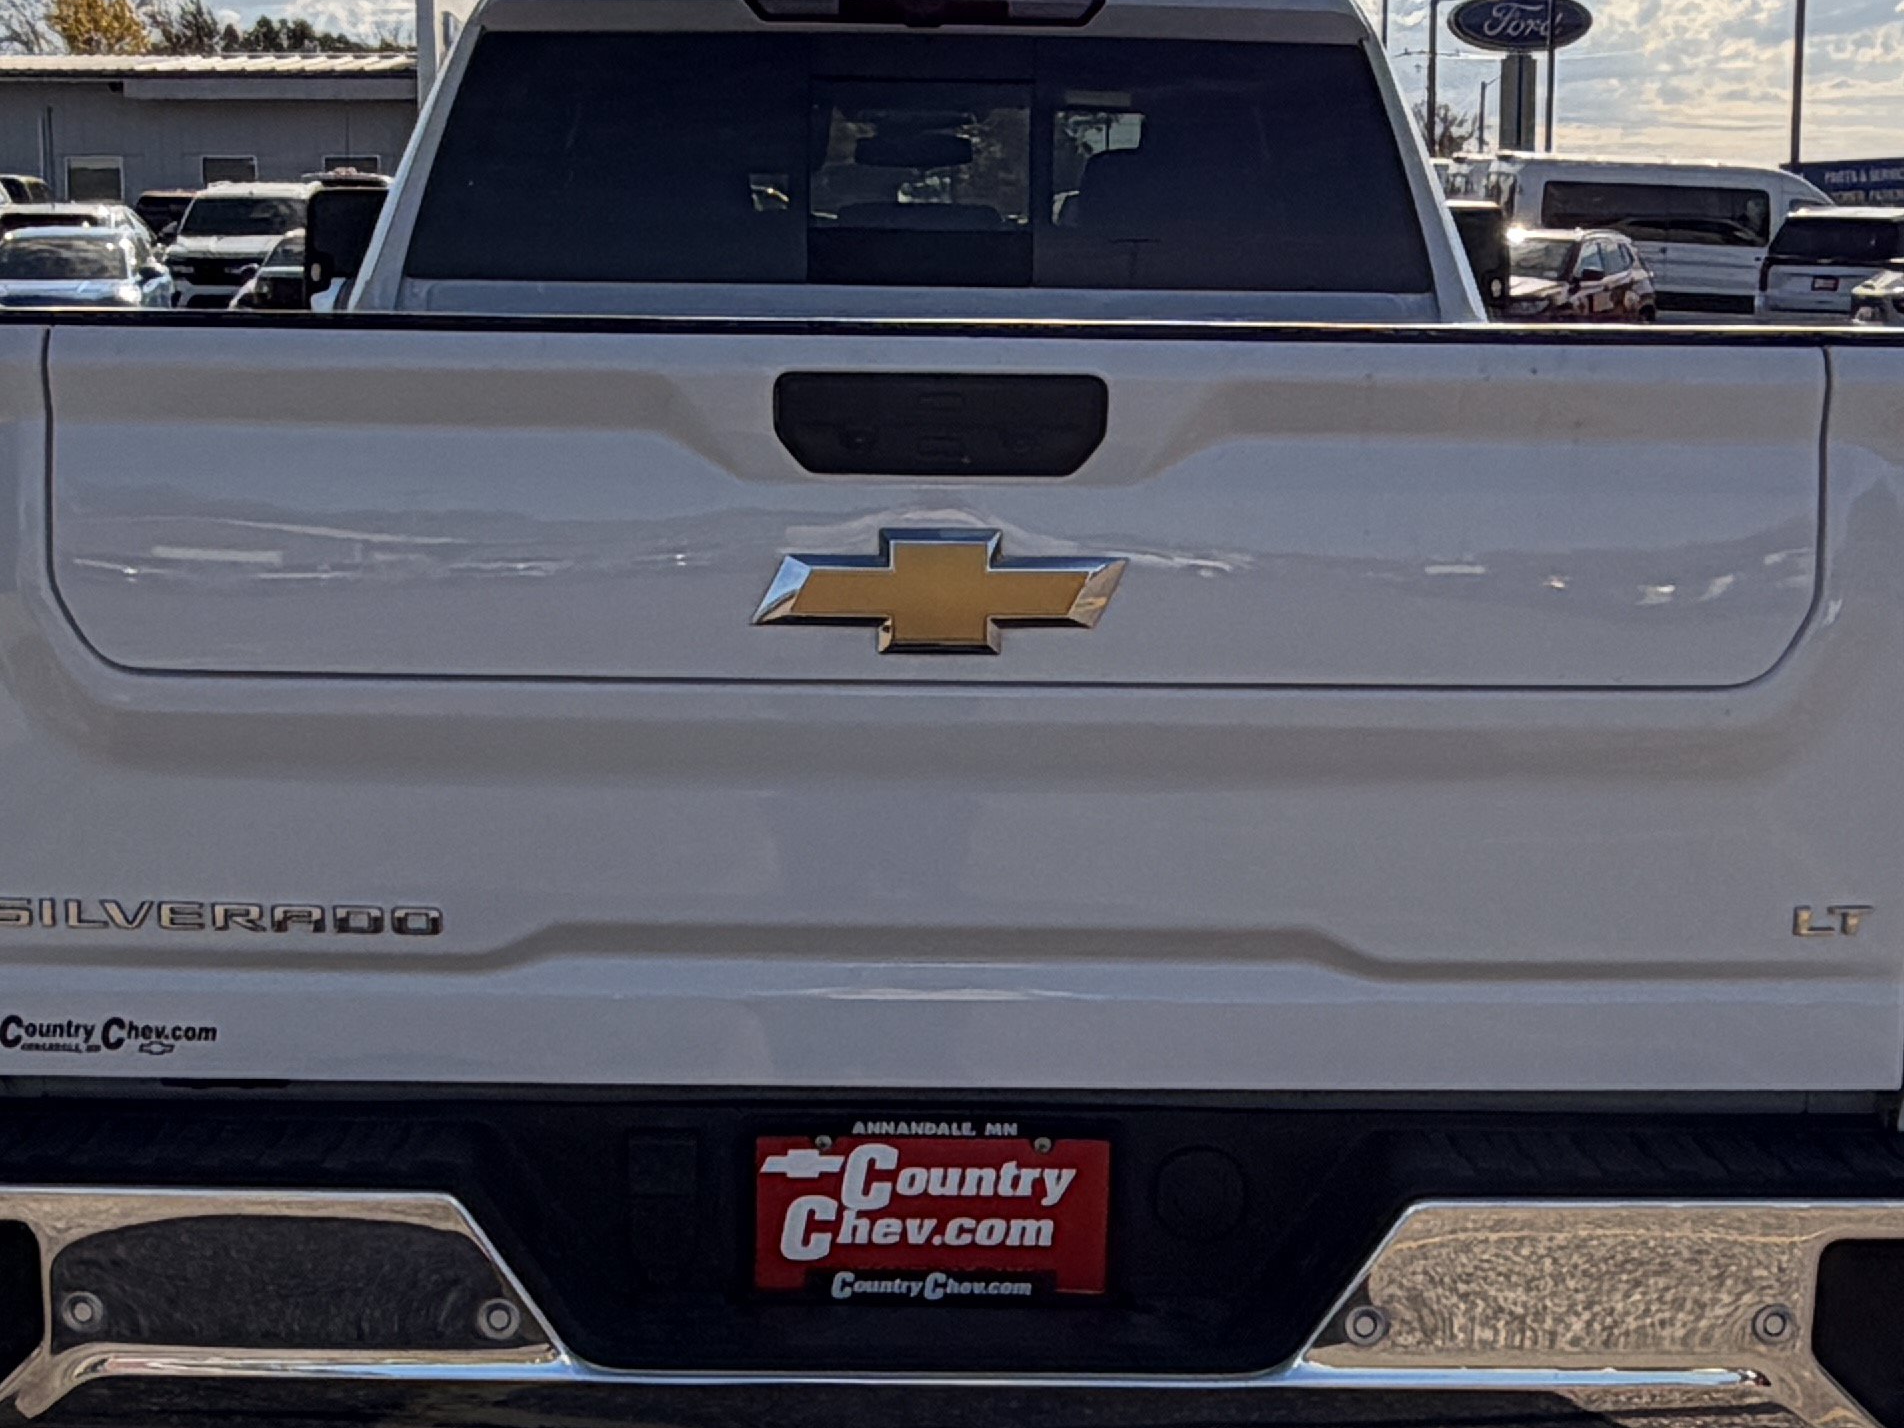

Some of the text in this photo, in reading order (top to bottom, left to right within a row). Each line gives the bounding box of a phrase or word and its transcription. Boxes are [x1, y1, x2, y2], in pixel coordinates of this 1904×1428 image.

[1483, 2, 1564, 37] Ford
[1792, 904, 1874, 937] LT
[984, 1122, 1018, 1136] MN
[841, 1143, 1077, 1211] Country
[780, 1194, 1054, 1262] Chev.com
